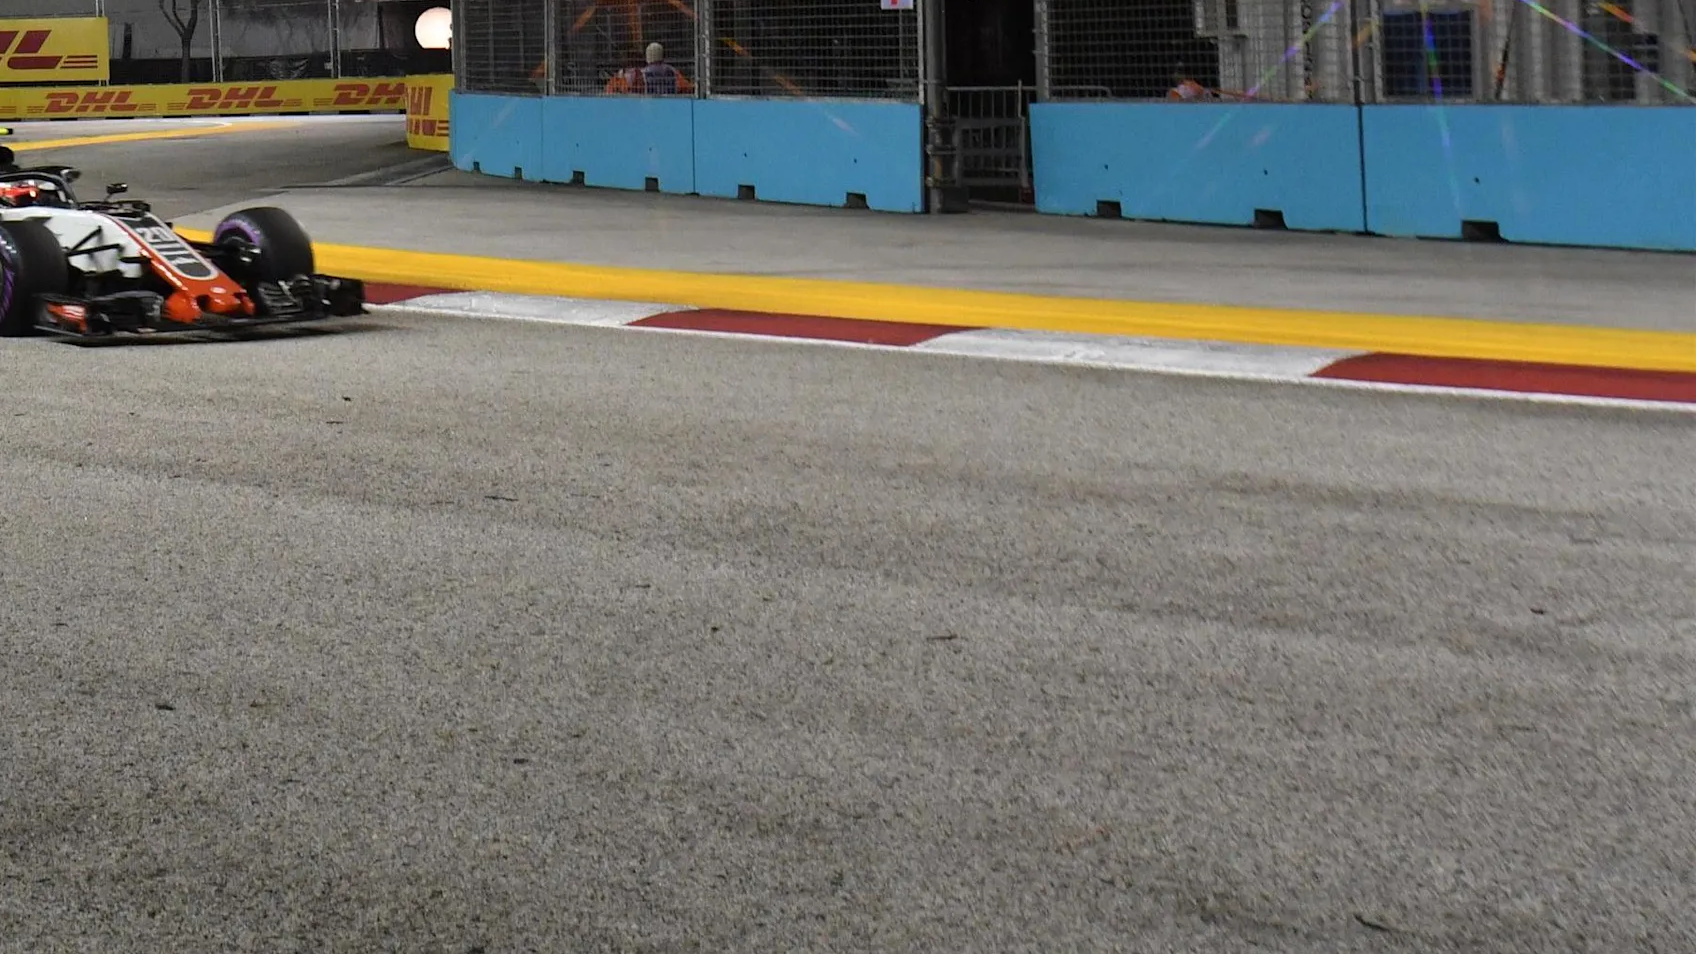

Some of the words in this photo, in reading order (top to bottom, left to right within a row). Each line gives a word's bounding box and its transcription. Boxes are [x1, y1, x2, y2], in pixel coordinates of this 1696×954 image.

[44, 92, 138, 113] DHL
[186, 86, 292, 110] DHL
[333, 82, 406, 105] DH
